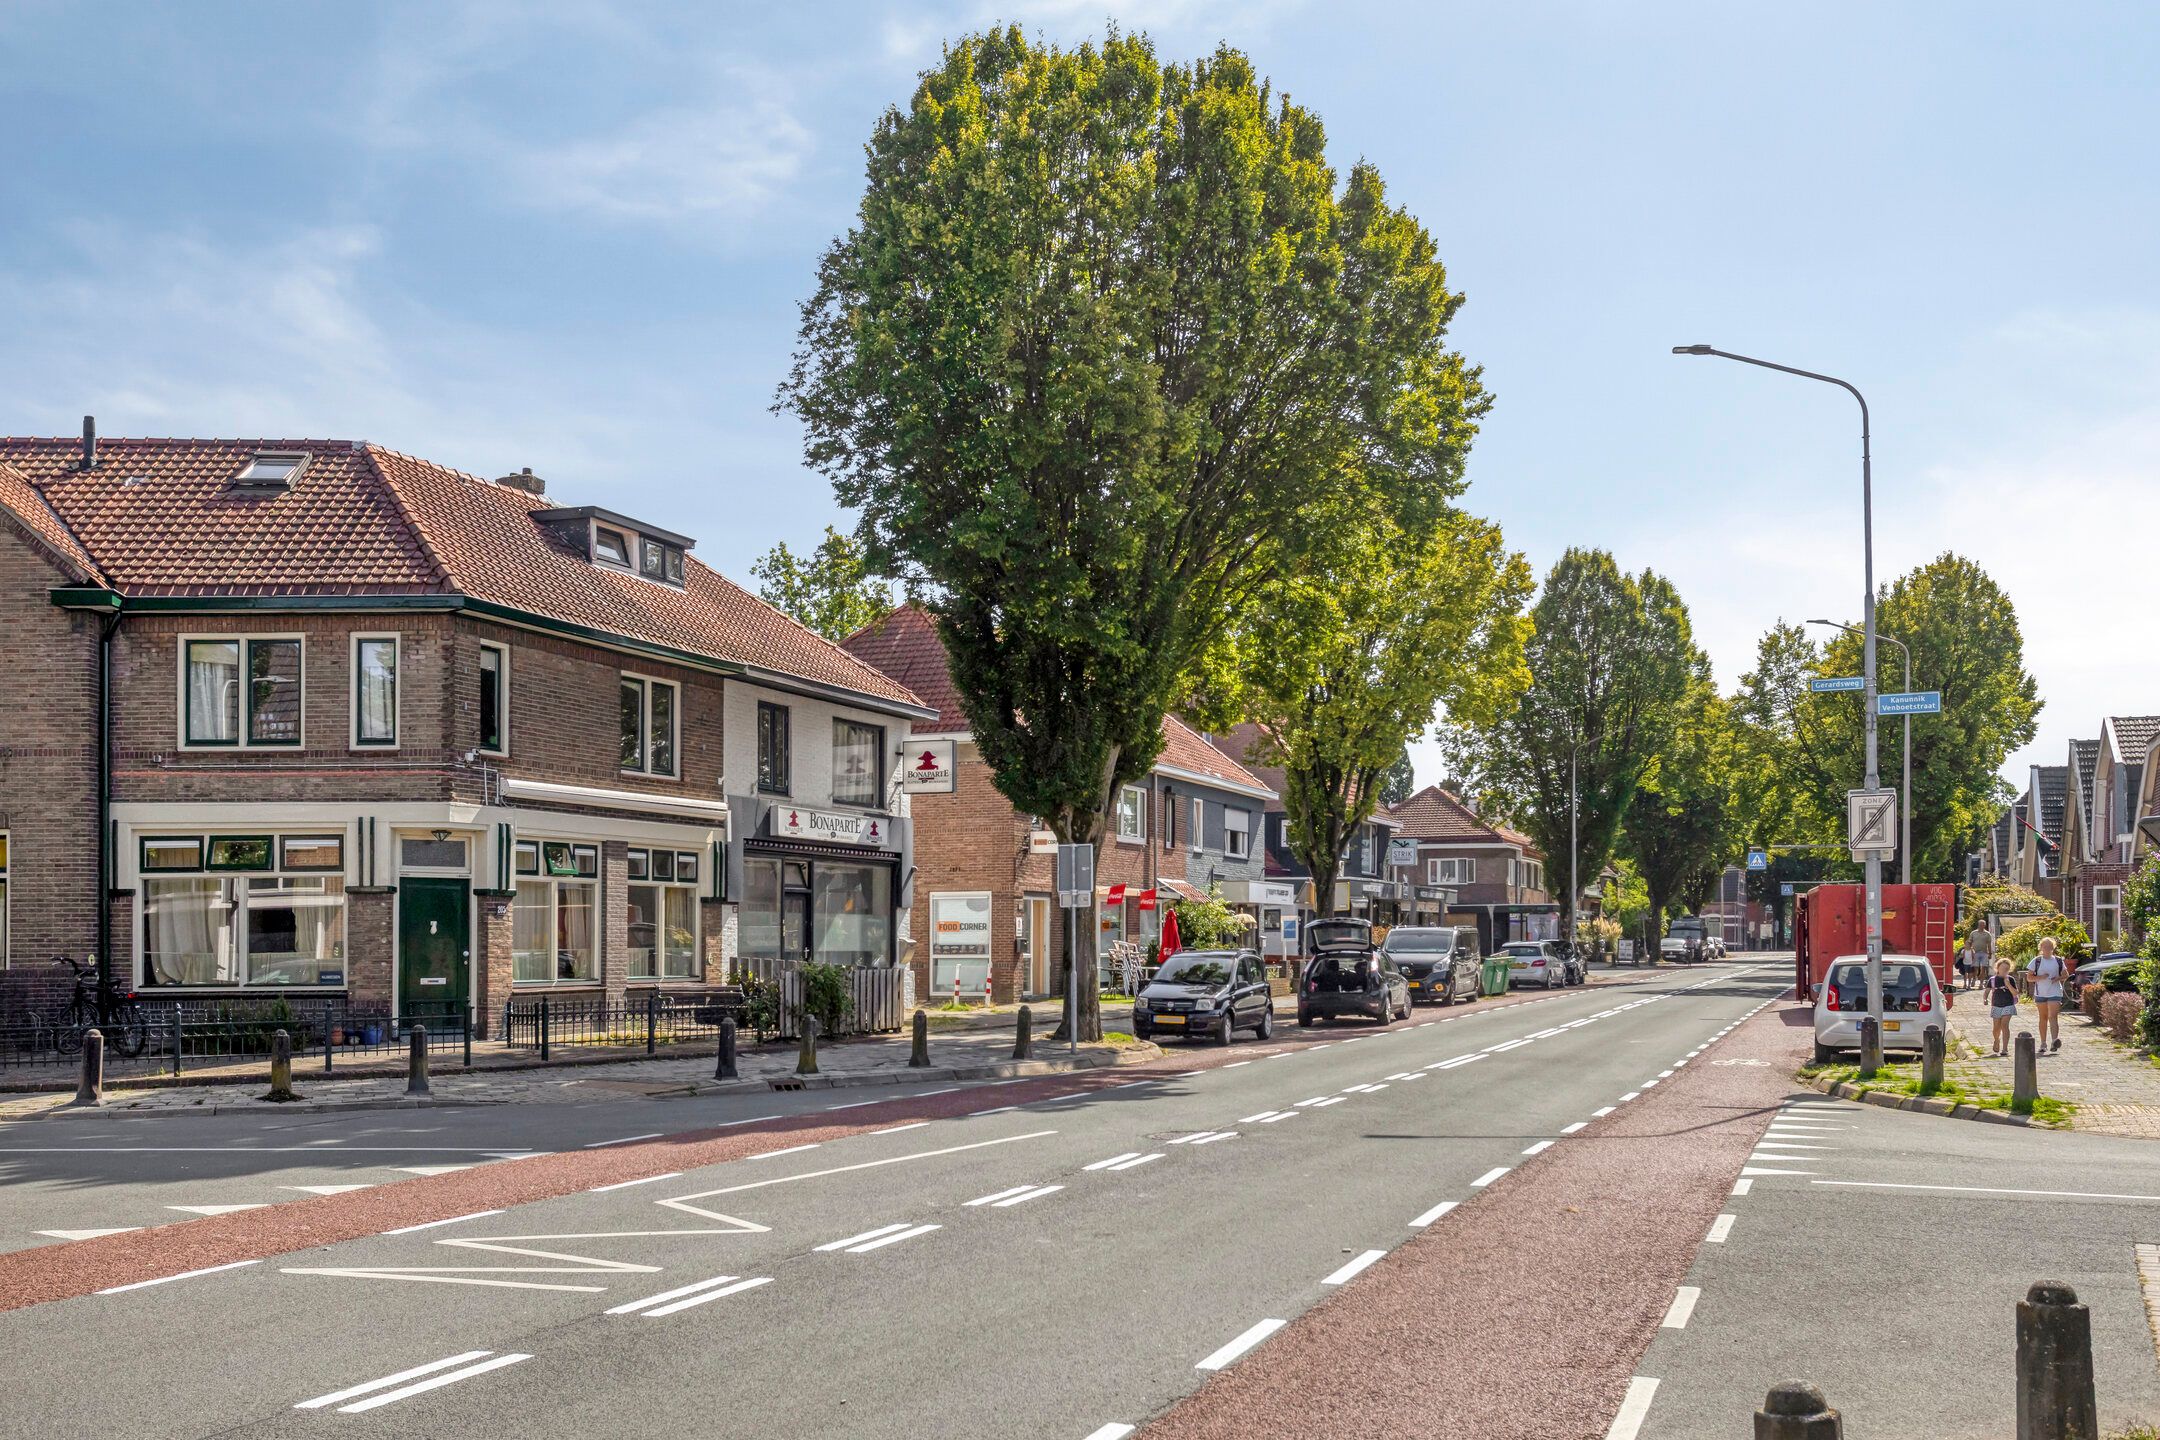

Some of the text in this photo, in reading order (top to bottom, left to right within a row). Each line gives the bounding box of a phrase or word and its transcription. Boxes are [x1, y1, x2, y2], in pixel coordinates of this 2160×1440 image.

[1815, 681, 1859, 689] Gerardsweg
[1890, 696, 1926, 704] Kanunnik
[1882, 703, 1936, 712] Venboetstraat
[907, 770, 949, 778] BONAPARTE
[809, 812, 861, 833] BONAPARTE
[938, 922, 988, 931] FOOD CORNER
